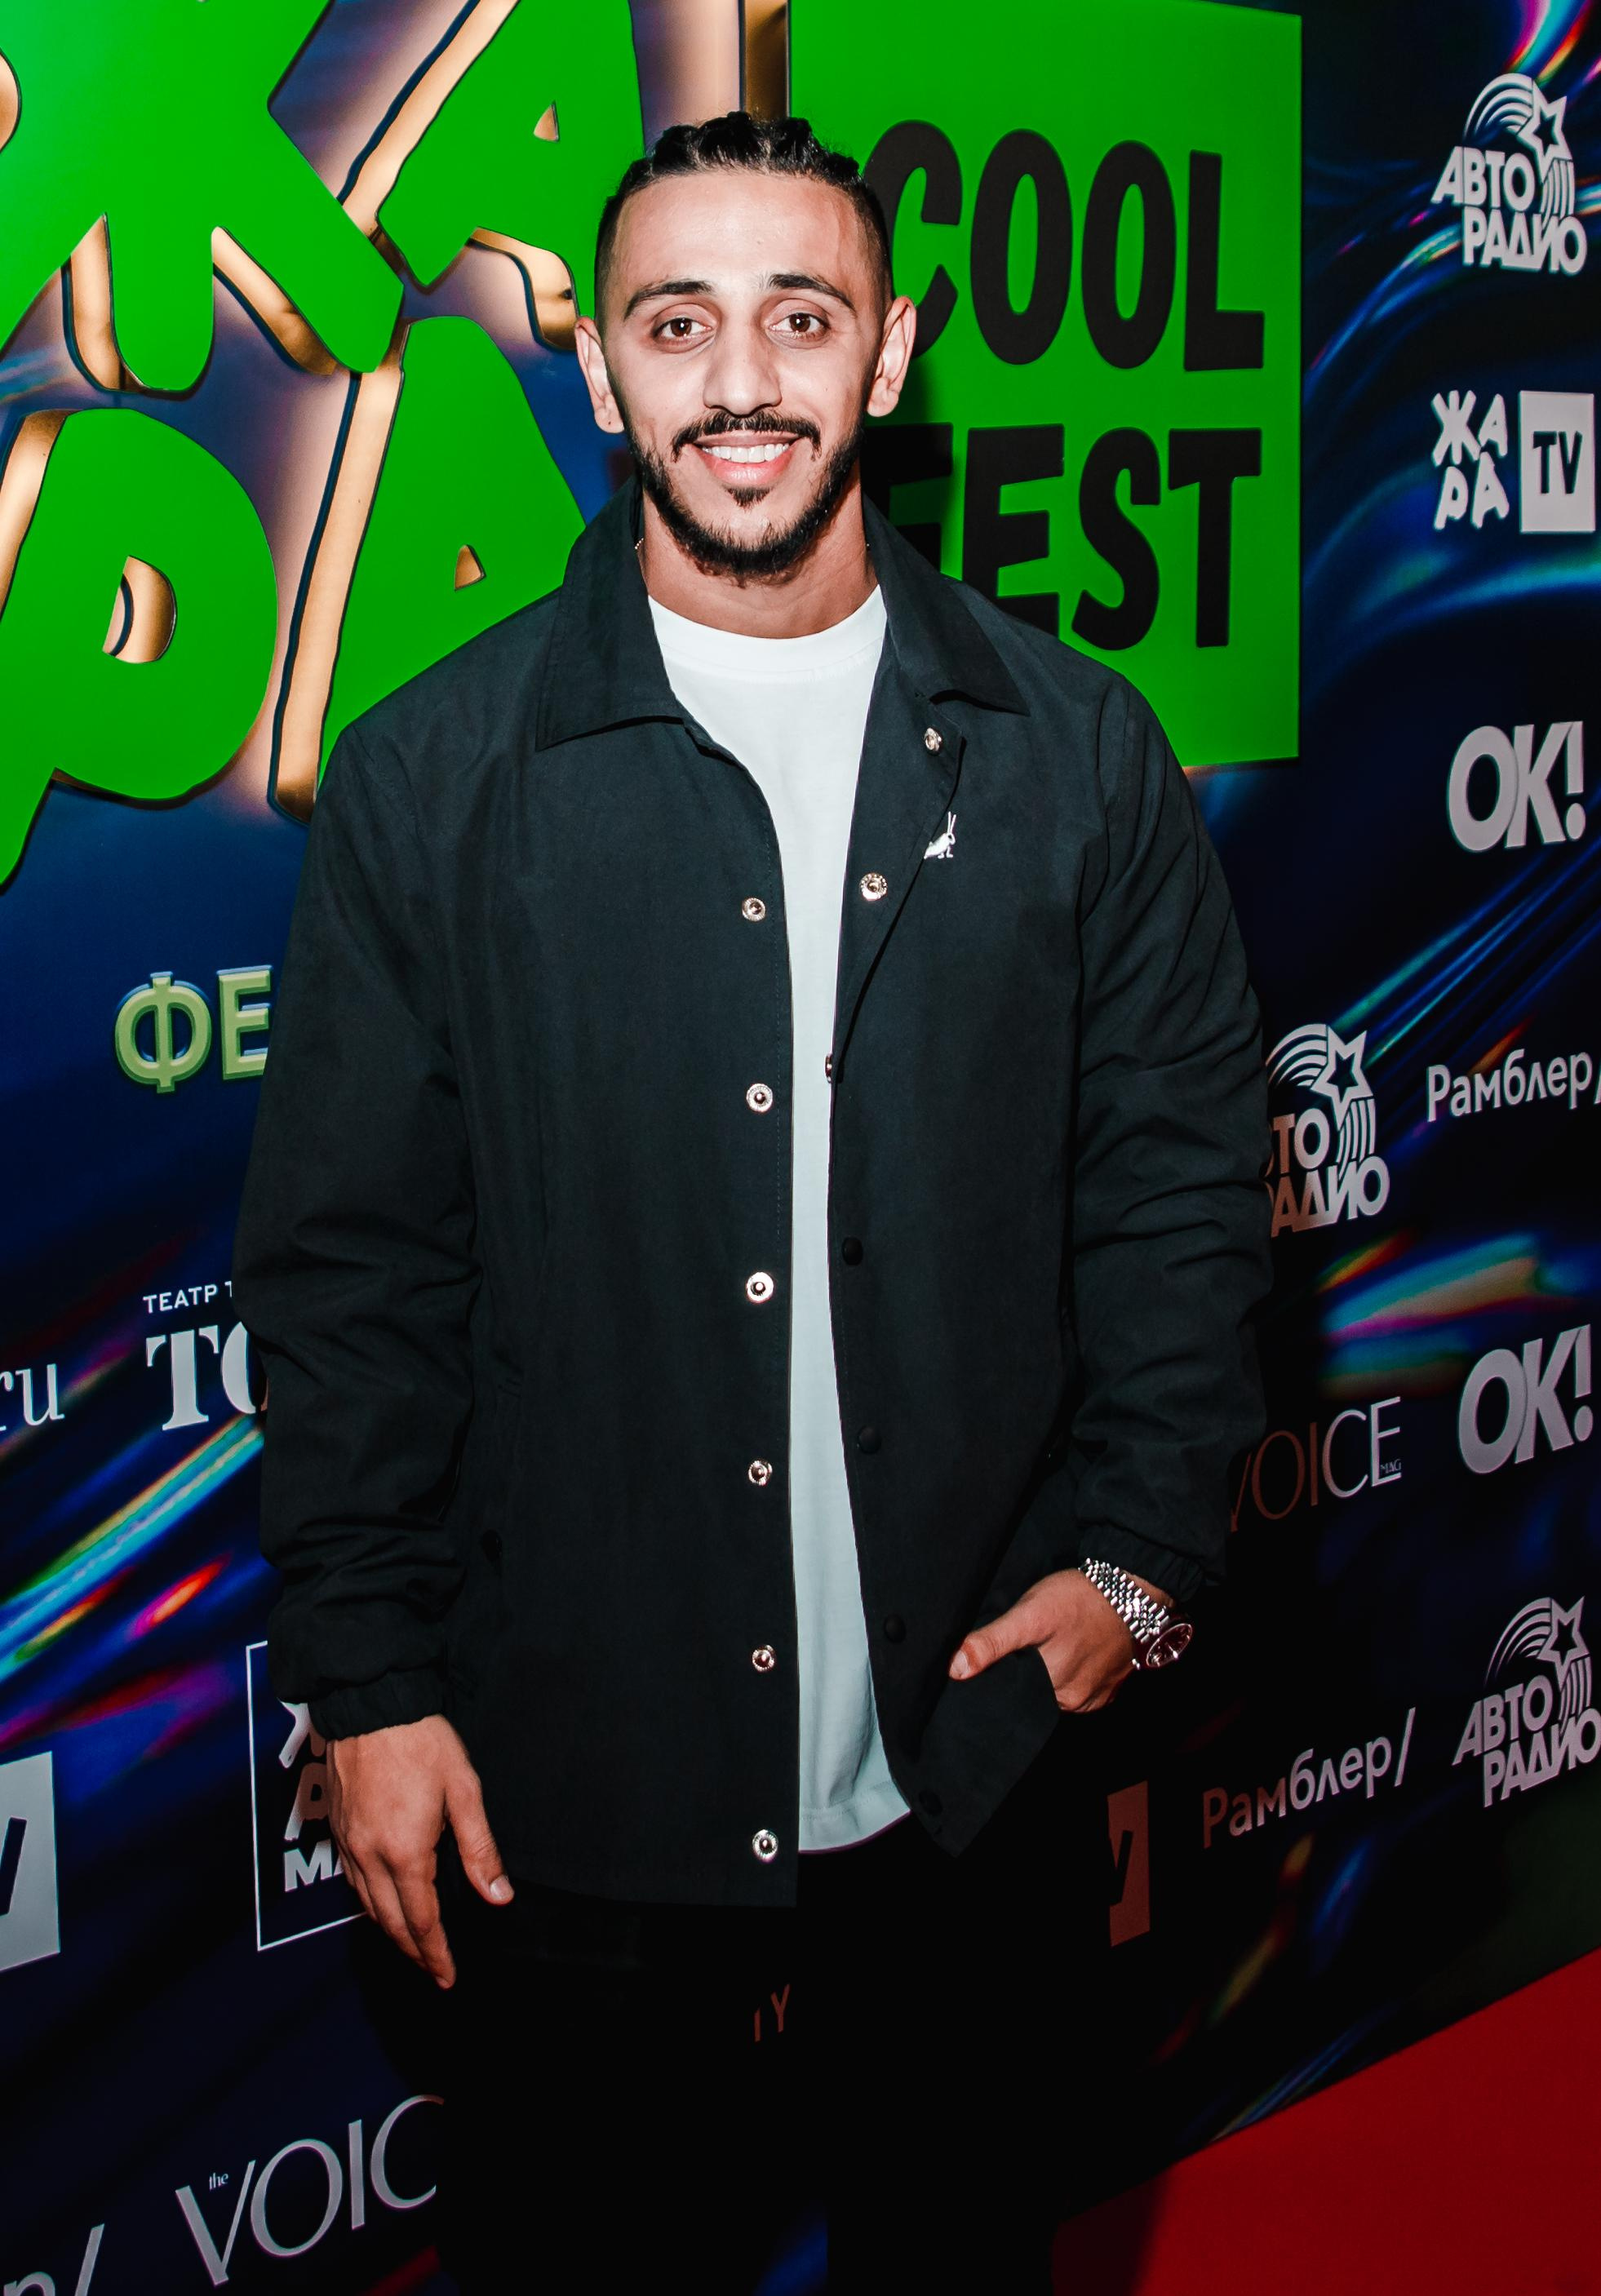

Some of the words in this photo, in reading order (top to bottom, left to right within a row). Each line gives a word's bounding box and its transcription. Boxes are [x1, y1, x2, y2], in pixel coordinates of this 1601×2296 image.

[1430, 145, 1536, 211] АВТО
[859, 119, 1265, 371] COOL
[1463, 206, 1588, 276] РАДИО
[1431, 389, 1509, 467] ЖА
[1532, 431, 1583, 494] TV
[1433, 450, 1510, 530] РА
[860, 423, 1261, 651] FEST
[1448, 720, 1587, 852] OK!
[1268, 1108, 1330, 1178] ТО
[1264, 1155, 1390, 1239] АДИО
[142, 1284, 218, 1314] ТЕАТР
[1457, 1324, 1592, 1474] OK!
[1452, 1674, 1554, 1766] АВТО
[1483, 1708, 1601, 1808] РАДИО
[1202, 1707, 1416, 1850] Рамблер/
[208, 2171, 229, 2191] the
